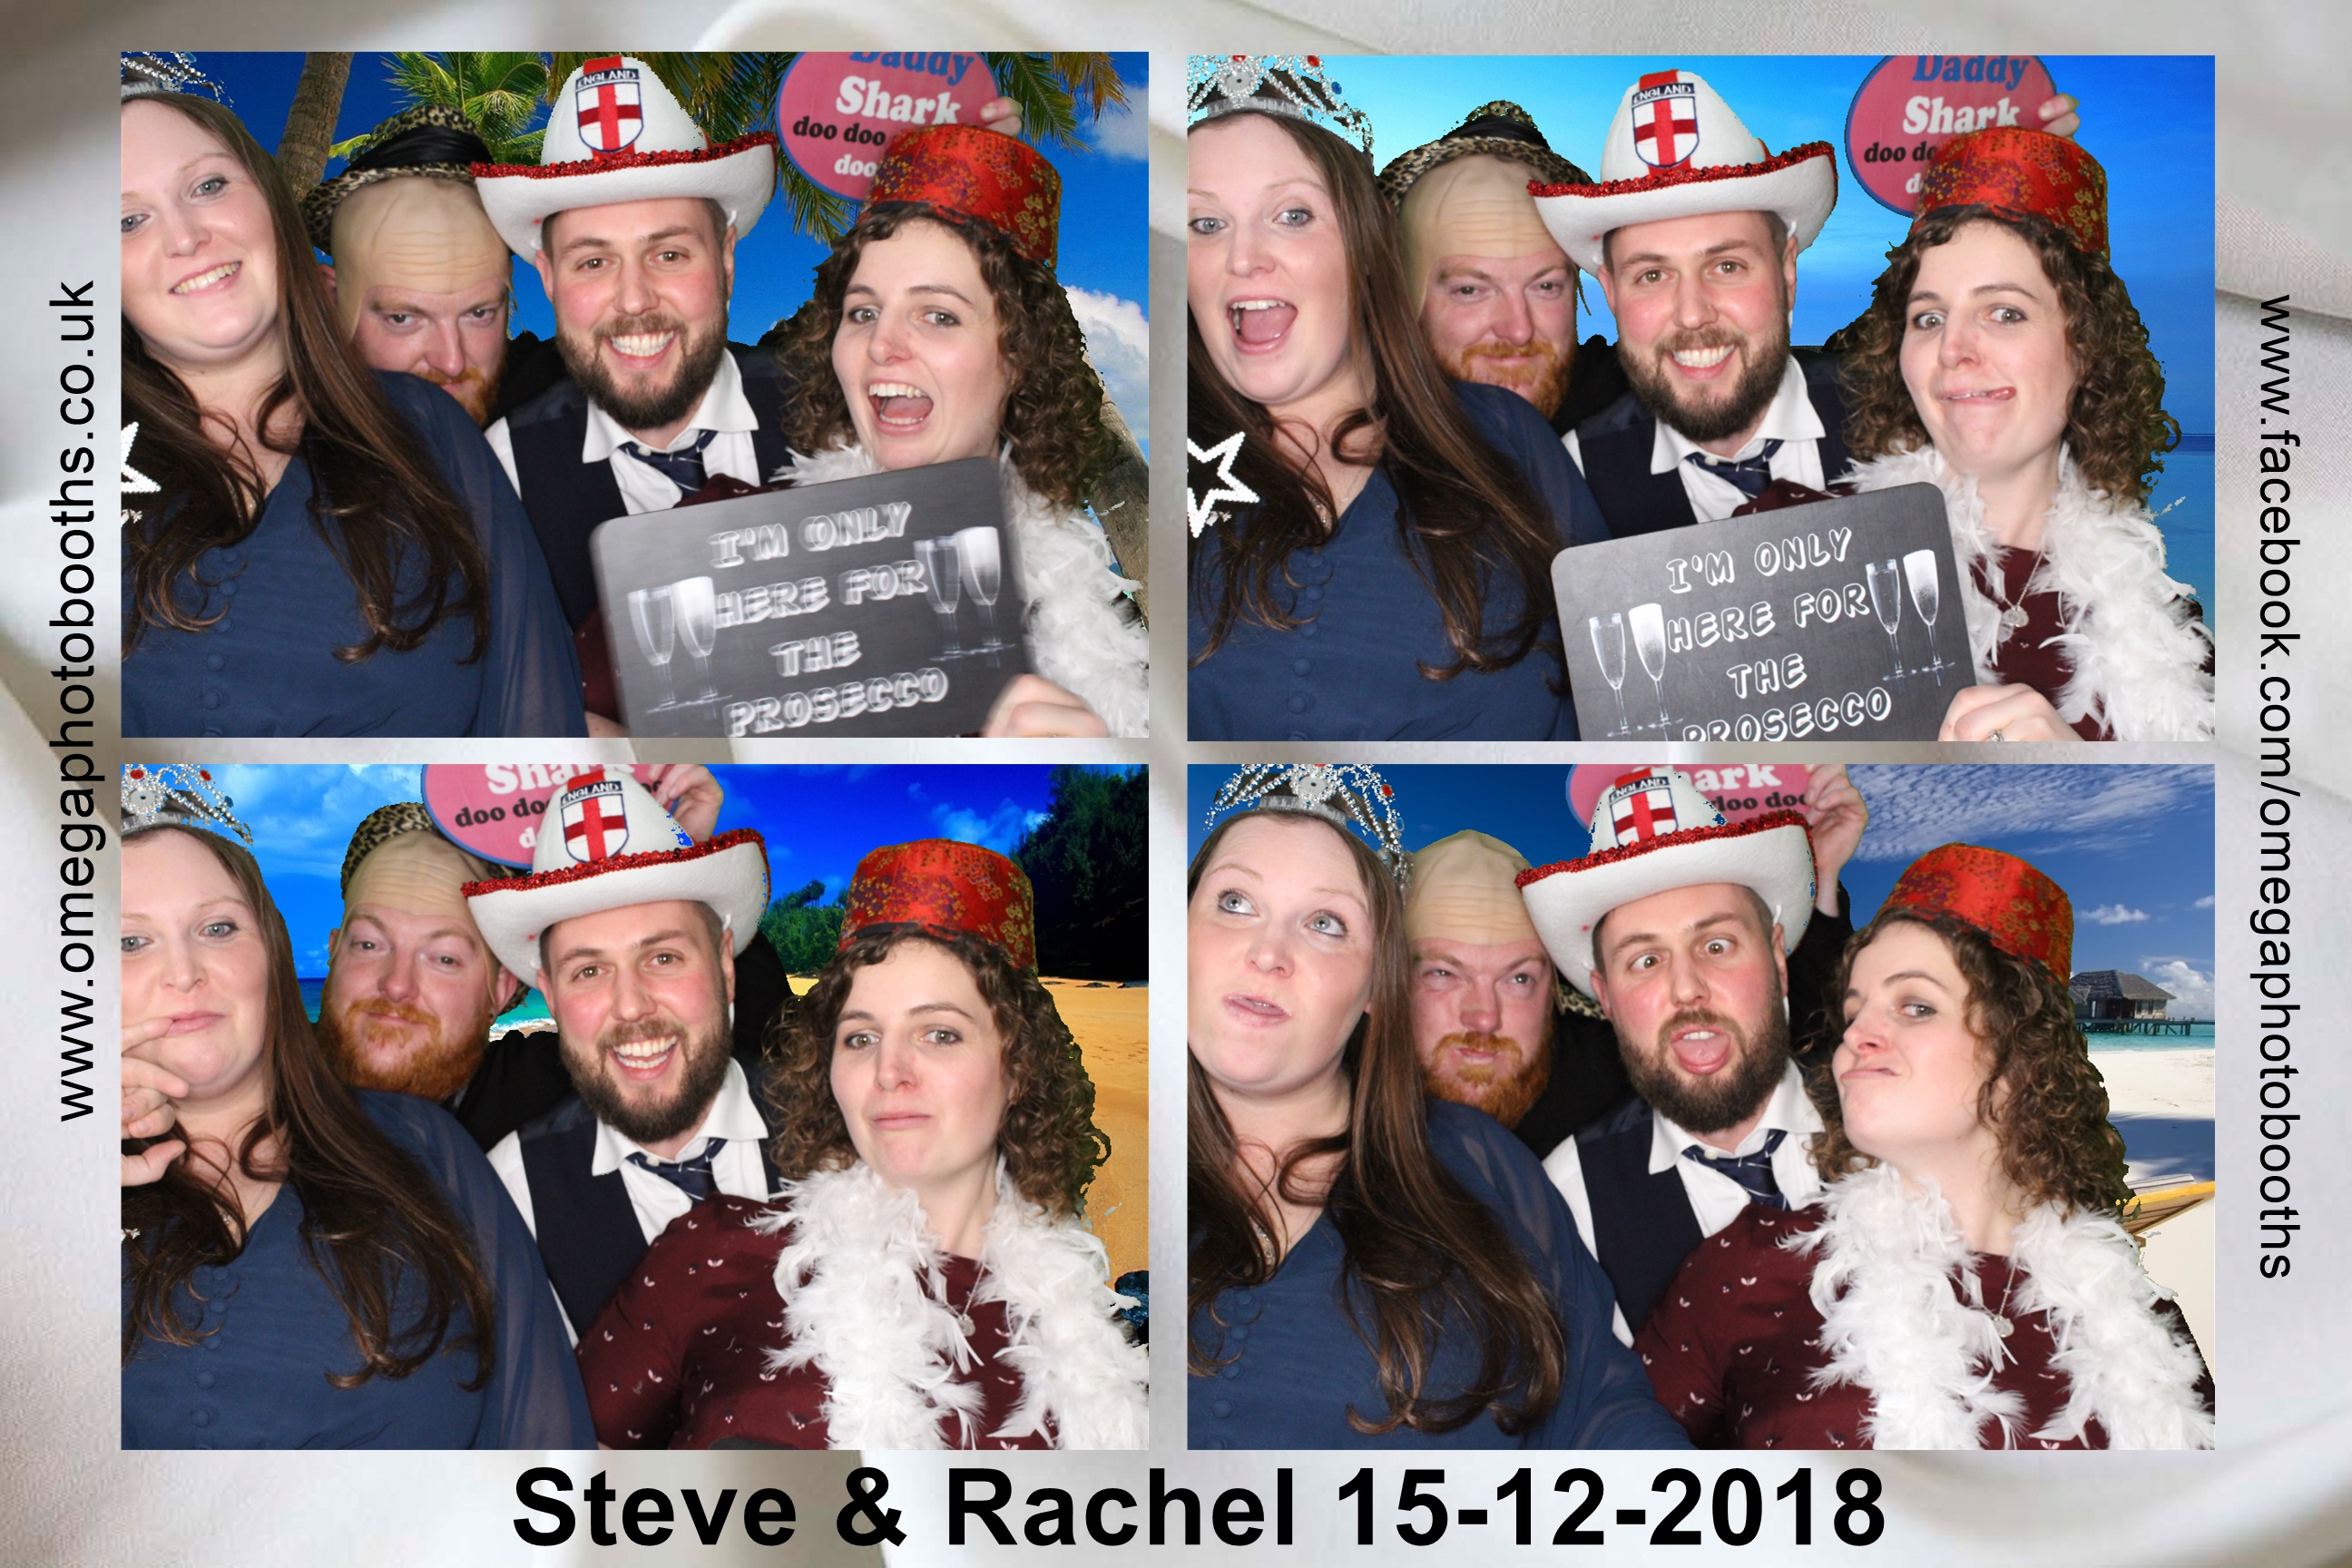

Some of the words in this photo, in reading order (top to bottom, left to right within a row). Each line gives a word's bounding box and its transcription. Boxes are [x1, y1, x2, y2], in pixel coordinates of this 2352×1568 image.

[578, 70, 636, 88] ENGLAND
[1912, 55, 2030, 92] Daddy
[836, 75, 961, 125] Shark
[1634, 84, 1691, 104] ENGLAND
[793, 116, 838, 140] doo
[844, 122, 886, 146] doo
[1903, 95, 2020, 134] Shark
[834, 153, 877, 178] doo
[1864, 142, 1906, 162] doo
[707, 524, 789, 569] I'M
[798, 502, 912, 552] ONLY
[1666, 551, 1735, 593] I'M
[1754, 527, 1852, 576] ONLY
[713, 576, 830, 629] HERE
[838, 560, 928, 605] FOR
[1667, 601, 1776, 652] HERE
[1793, 583, 1870, 628] FOR
[769, 631, 862, 677] THE
[1727, 652, 1808, 699] THE
[722, 667, 949, 738] PROSECCO
[562, 782, 619, 804] ENGLAND
[1611, 779, 1667, 801] ENGLAND
[455, 807, 505, 828] doo
[513, 797, 551, 818] do
